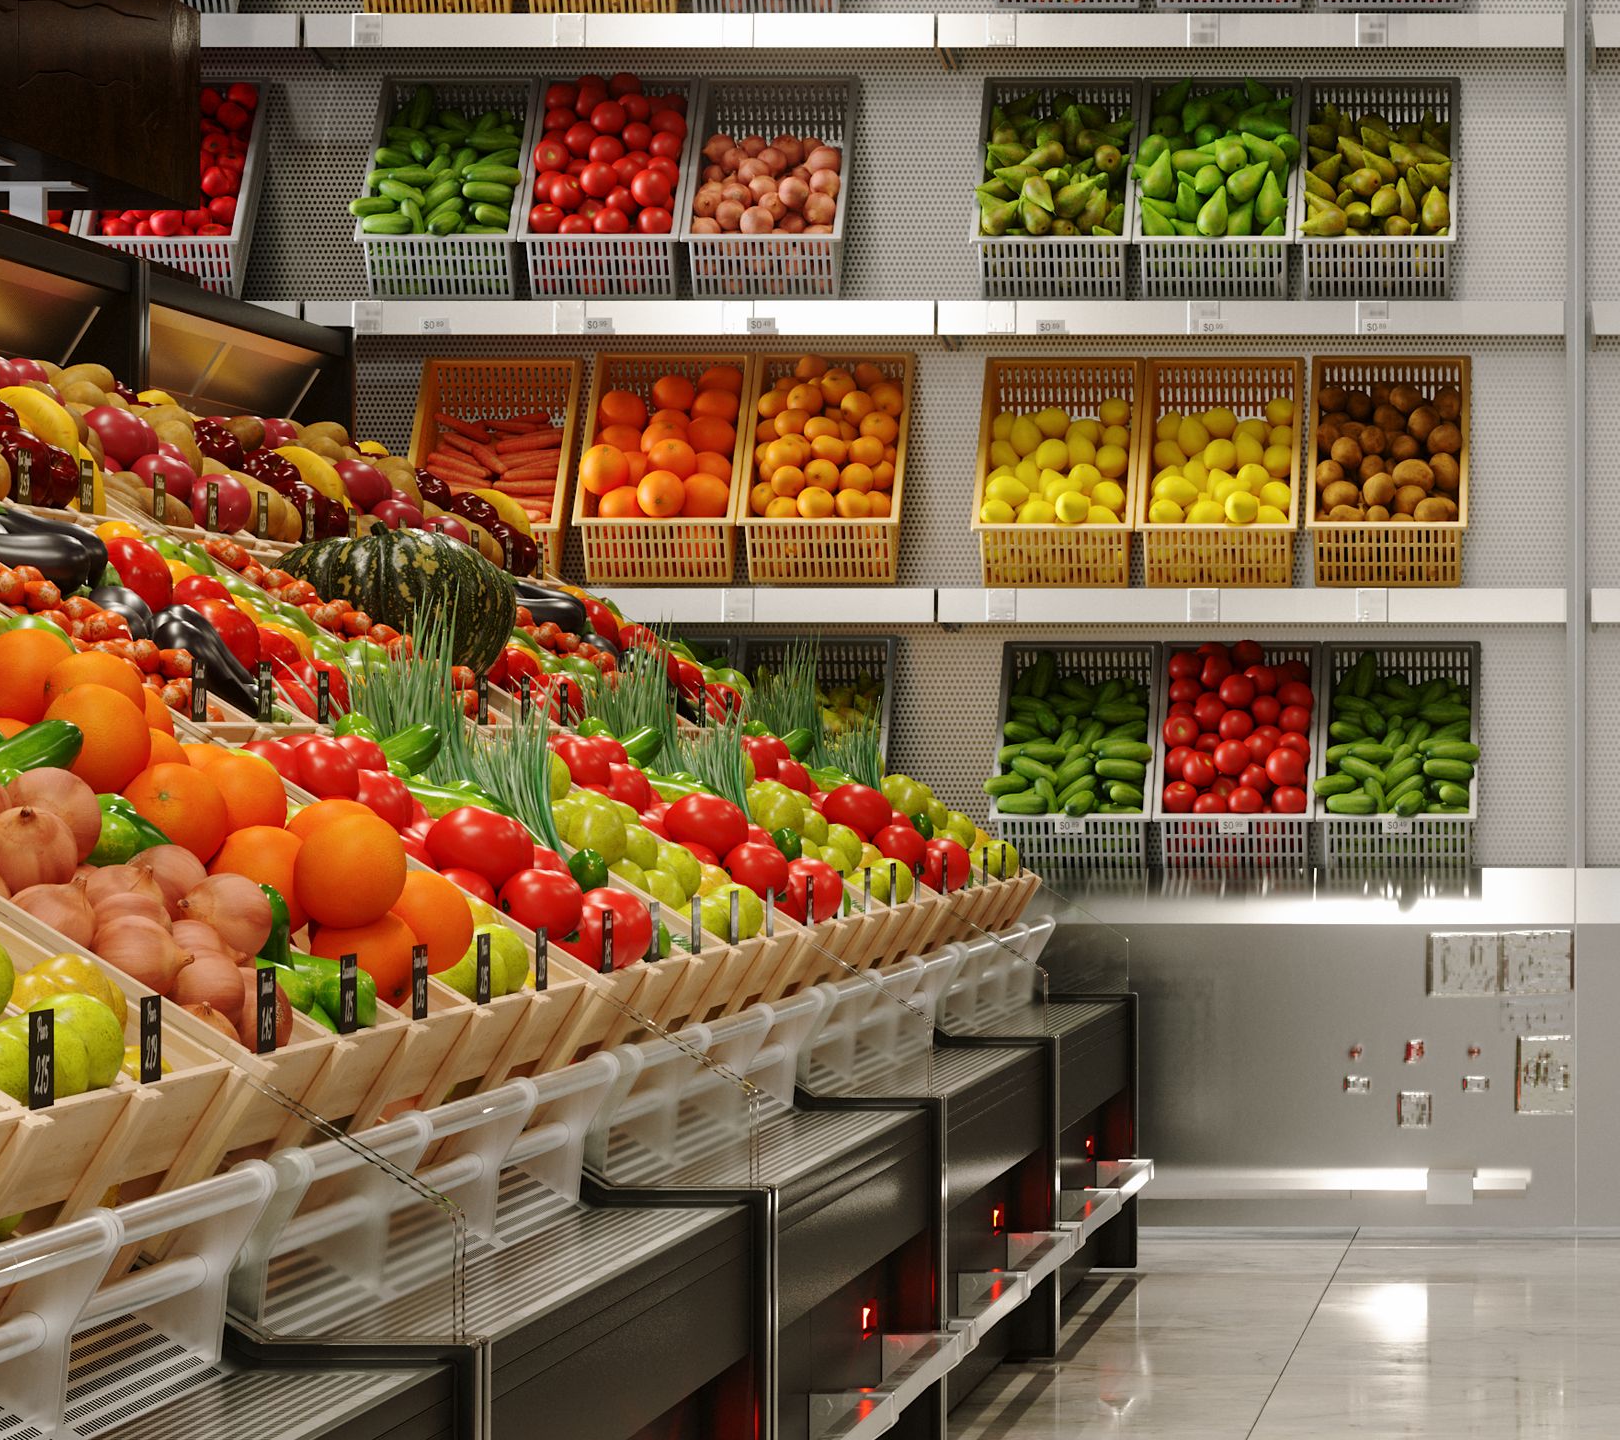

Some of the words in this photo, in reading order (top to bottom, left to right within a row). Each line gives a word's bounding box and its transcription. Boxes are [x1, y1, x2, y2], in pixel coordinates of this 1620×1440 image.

[147, 1001, 157, 1024] Pear
[37, 1015, 48, 1043] Pear
[145, 1034, 158, 1070] 2.19
[34, 1054, 50, 1095] 2.15
